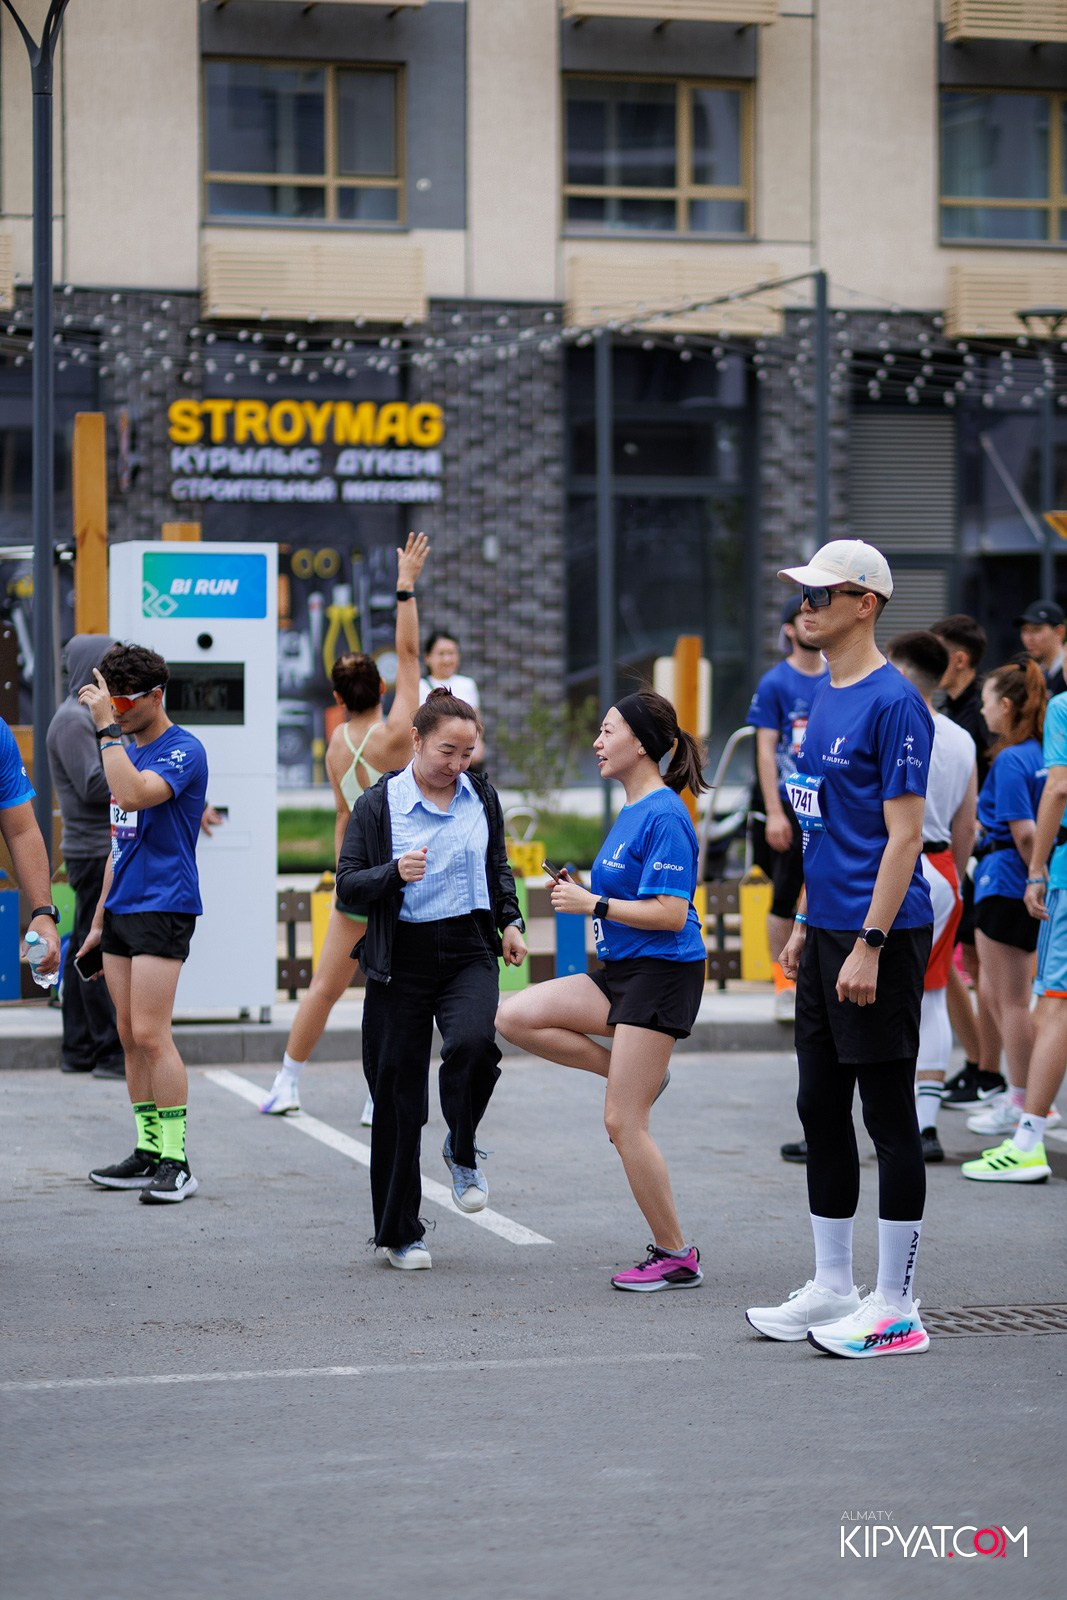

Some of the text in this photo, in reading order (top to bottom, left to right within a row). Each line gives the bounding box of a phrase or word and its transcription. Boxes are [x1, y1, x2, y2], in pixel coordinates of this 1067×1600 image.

[168, 399, 444, 446] STROYMAG
[170, 578, 239, 595] BI RUN
[791, 787, 813, 813] 1741
[663, 863, 684, 872] GROUP
[902, 1230, 919, 1297] ATHLEX
